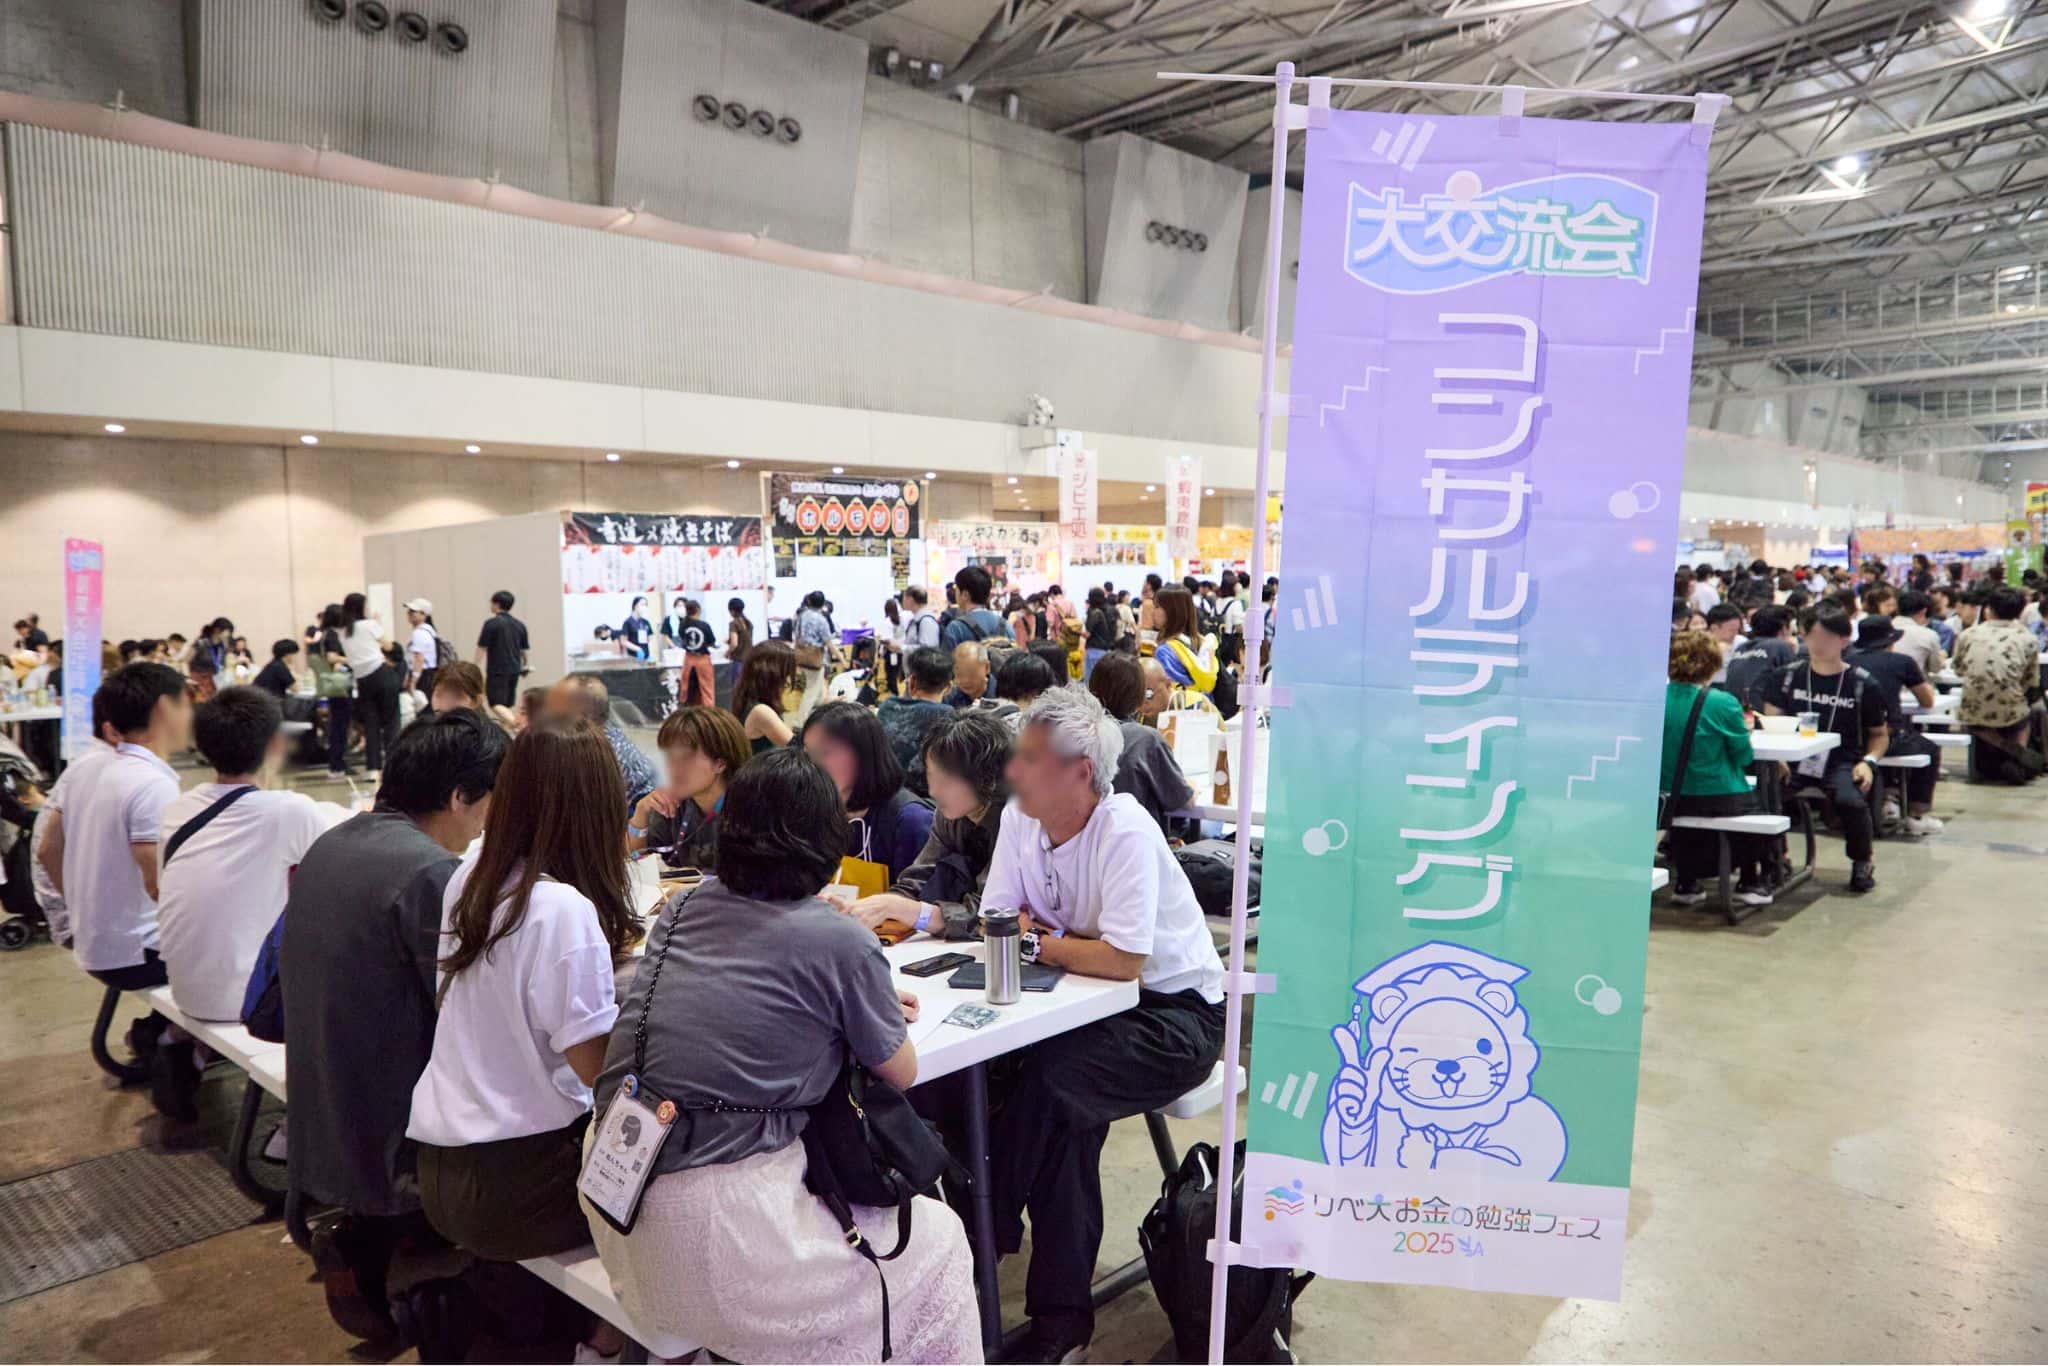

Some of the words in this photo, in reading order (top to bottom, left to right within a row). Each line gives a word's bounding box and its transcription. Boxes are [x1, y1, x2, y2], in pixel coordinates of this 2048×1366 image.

[1352, 174, 1640, 275] 大交流会
[1397, 311, 1543, 921] コンサルティング
[1313, 1194, 1602, 1241] リベ大お金の勉強フェス
[1393, 1231, 1455, 1255] 2025
